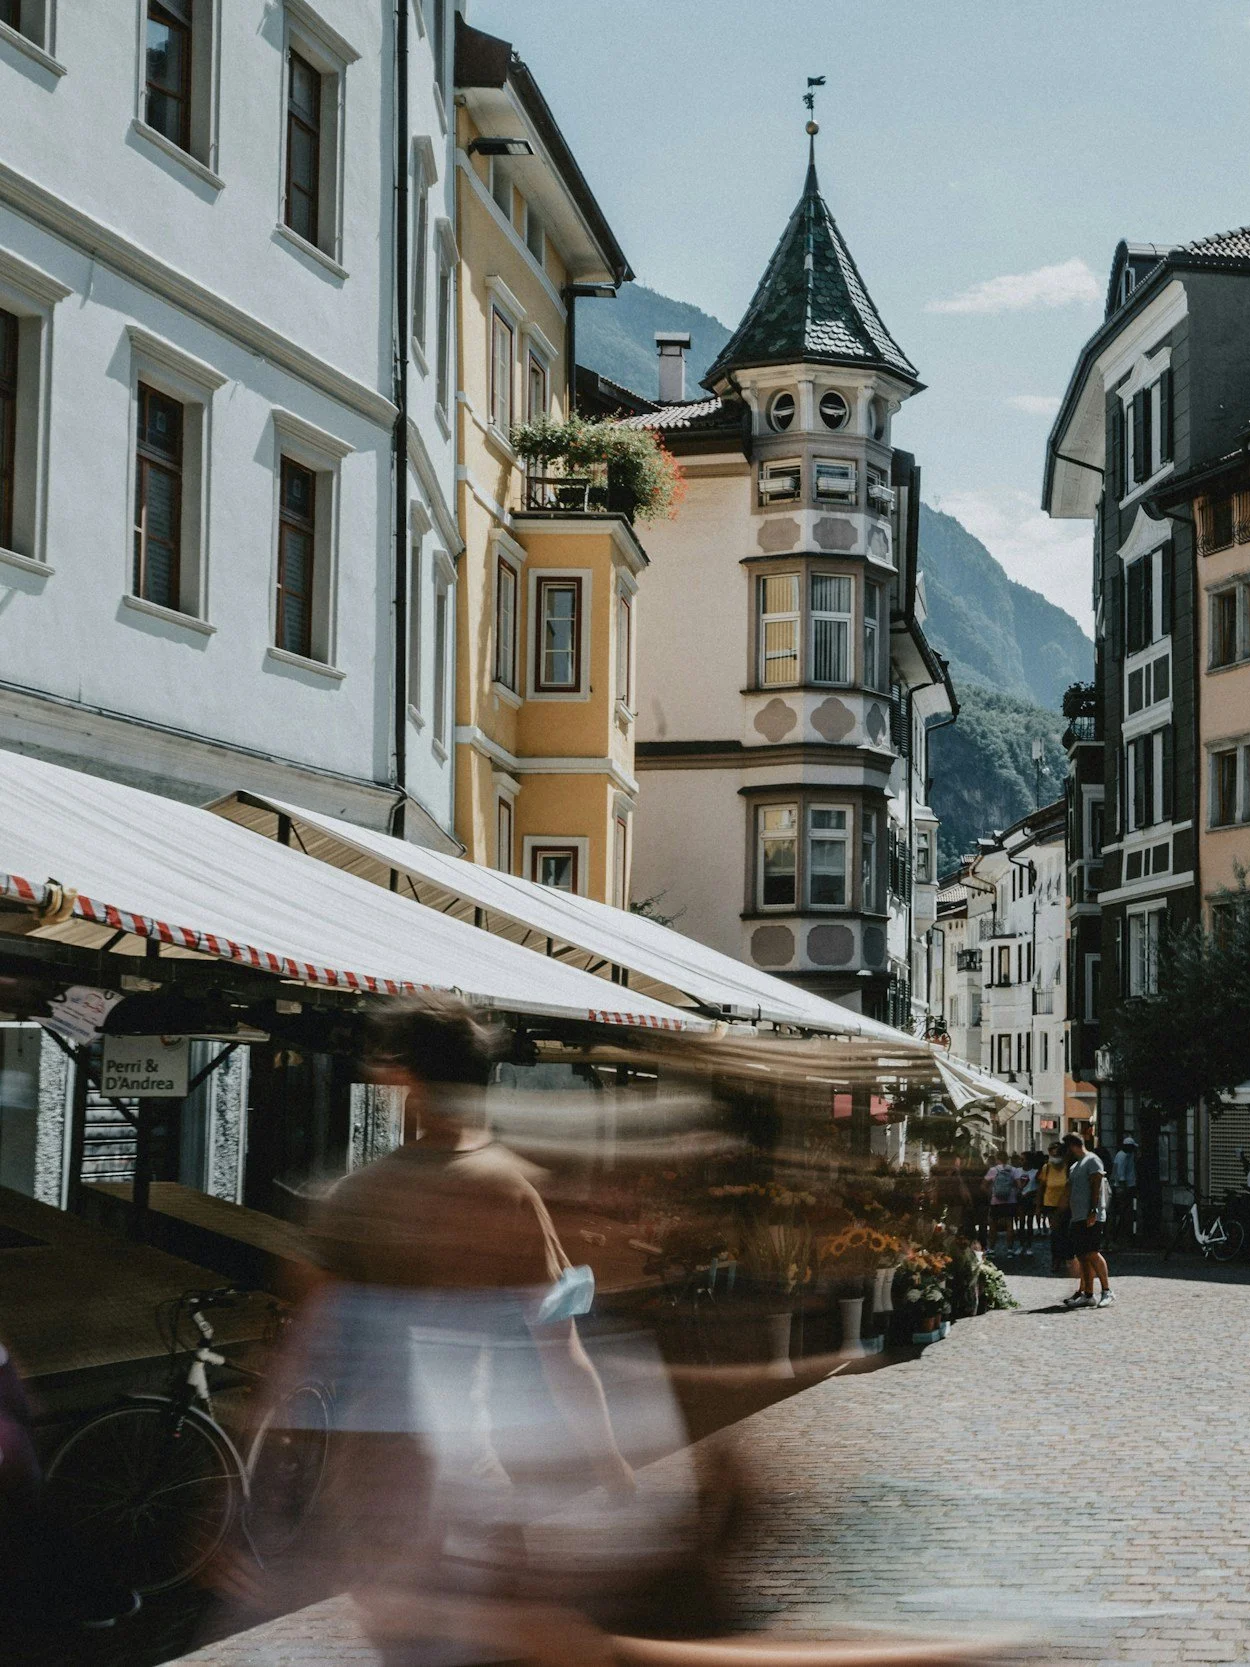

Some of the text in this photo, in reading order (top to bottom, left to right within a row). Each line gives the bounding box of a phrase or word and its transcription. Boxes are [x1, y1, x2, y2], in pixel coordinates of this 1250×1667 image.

[105, 1059, 159, 1073] Perri &
[105, 1076, 174, 1091] D'Andrea
